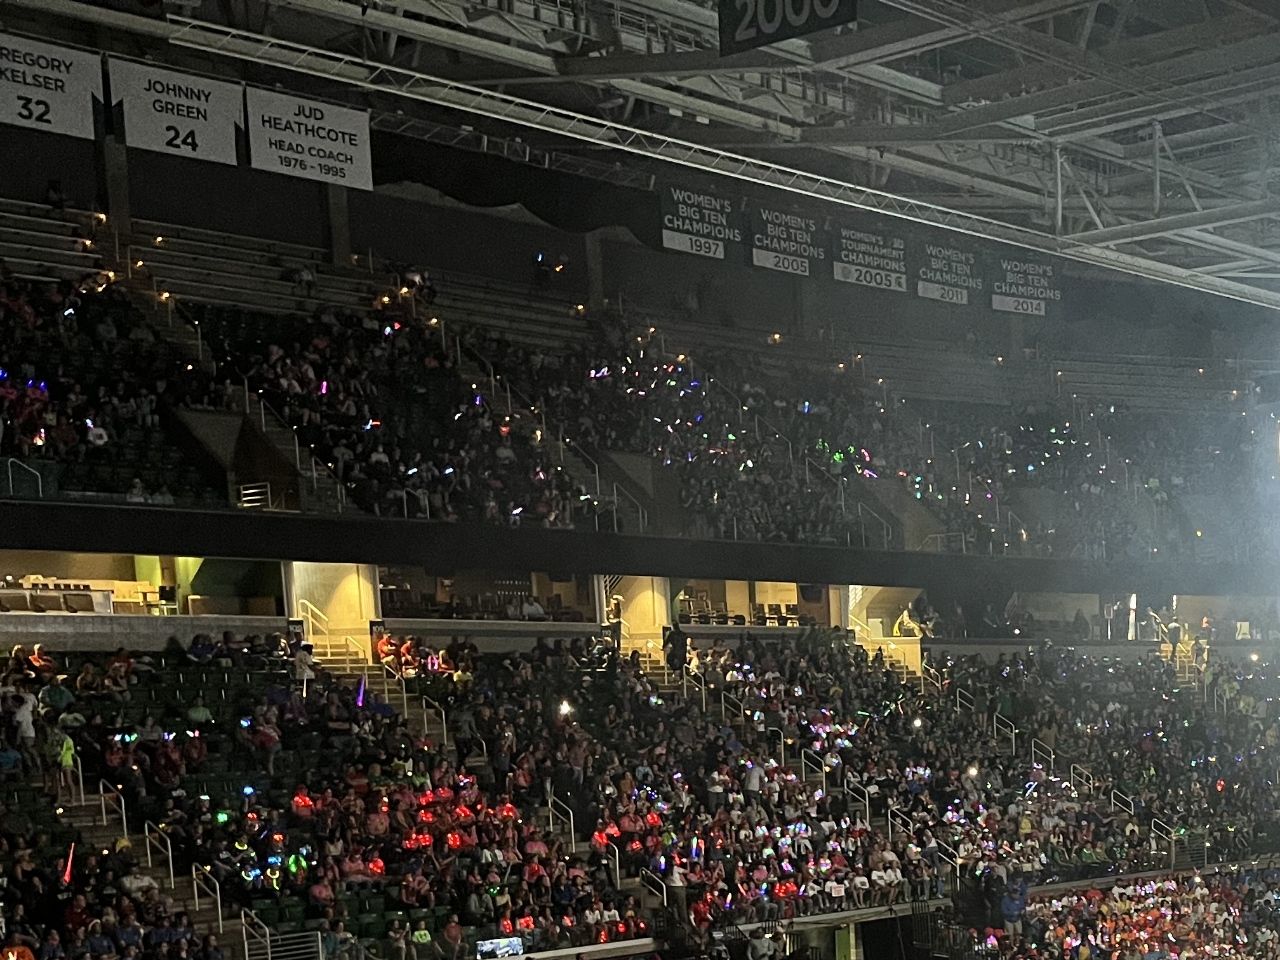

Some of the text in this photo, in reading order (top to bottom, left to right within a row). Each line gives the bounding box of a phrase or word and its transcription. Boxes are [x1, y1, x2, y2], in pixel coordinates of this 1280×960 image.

[0, 46, 73, 75] REGORY
[0, 67, 66, 93] KELSER
[143, 79, 212, 103] JOHNNY
[16, 95, 52, 124] 32
[152, 99, 208, 122] GREEN
[293, 104, 325, 121] JUD
[164, 125, 199, 152] 24
[261, 115, 359, 147] HEATHCOTE
[268, 137, 354, 165] HEAD COACH
[278, 155, 308, 171] 1976
[318, 163, 347, 179] 1995
[671, 187, 732, 213] WOMEN'S
[678, 204, 728, 226] BIG TEN
[760, 208, 817, 232] WOMEN'S
[664, 215, 742, 242] CHAMPIONS
[767, 223, 812, 245] BIG TEN
[688, 236, 721, 257] 1997
[754, 234, 826, 260] CHAMPIONS
[840, 239, 905, 261] TOURNAMENT
[926, 244, 976, 265] WOMEN'S
[773, 254, 808, 274] 2005
[841, 250, 907, 273] CHAMPIONS
[931, 258, 971, 275] BIG TEN
[1001, 259, 1053, 277] WOMEN'S
[854, 268, 893, 288] 2005
[919, 268, 983, 290] CHAMPIONS
[1006, 270, 1048, 288] BIG TEN
[939, 287, 964, 302] 2011
[994, 282, 1062, 301] CHAMPIONS
[1013, 299, 1042, 314] 2014
